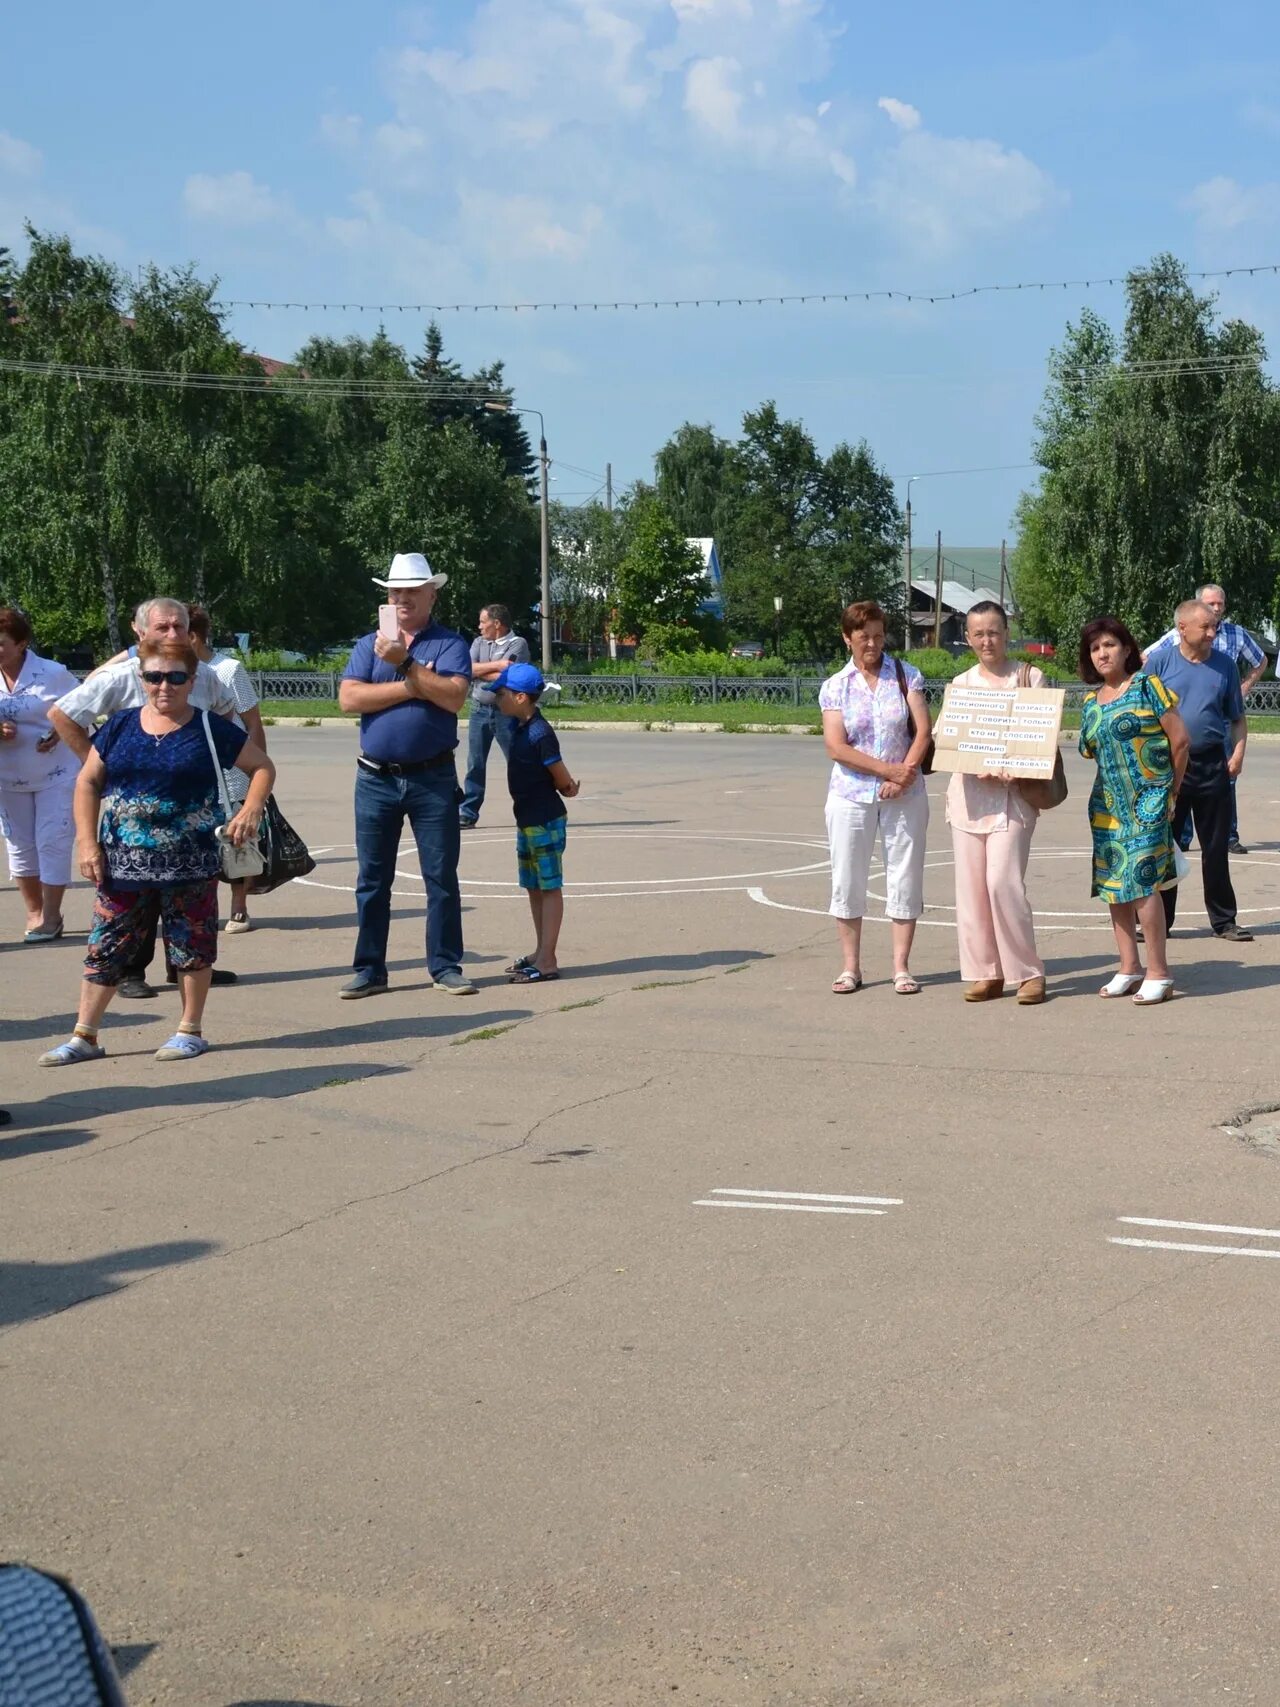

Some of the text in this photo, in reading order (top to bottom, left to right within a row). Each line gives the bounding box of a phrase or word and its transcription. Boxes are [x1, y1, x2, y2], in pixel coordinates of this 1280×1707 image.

[949, 701, 1053, 712] ПЕНСИОННОГО ВОЗРАСТА
[959, 743, 1005, 752] ПРАВИЛЬНО
